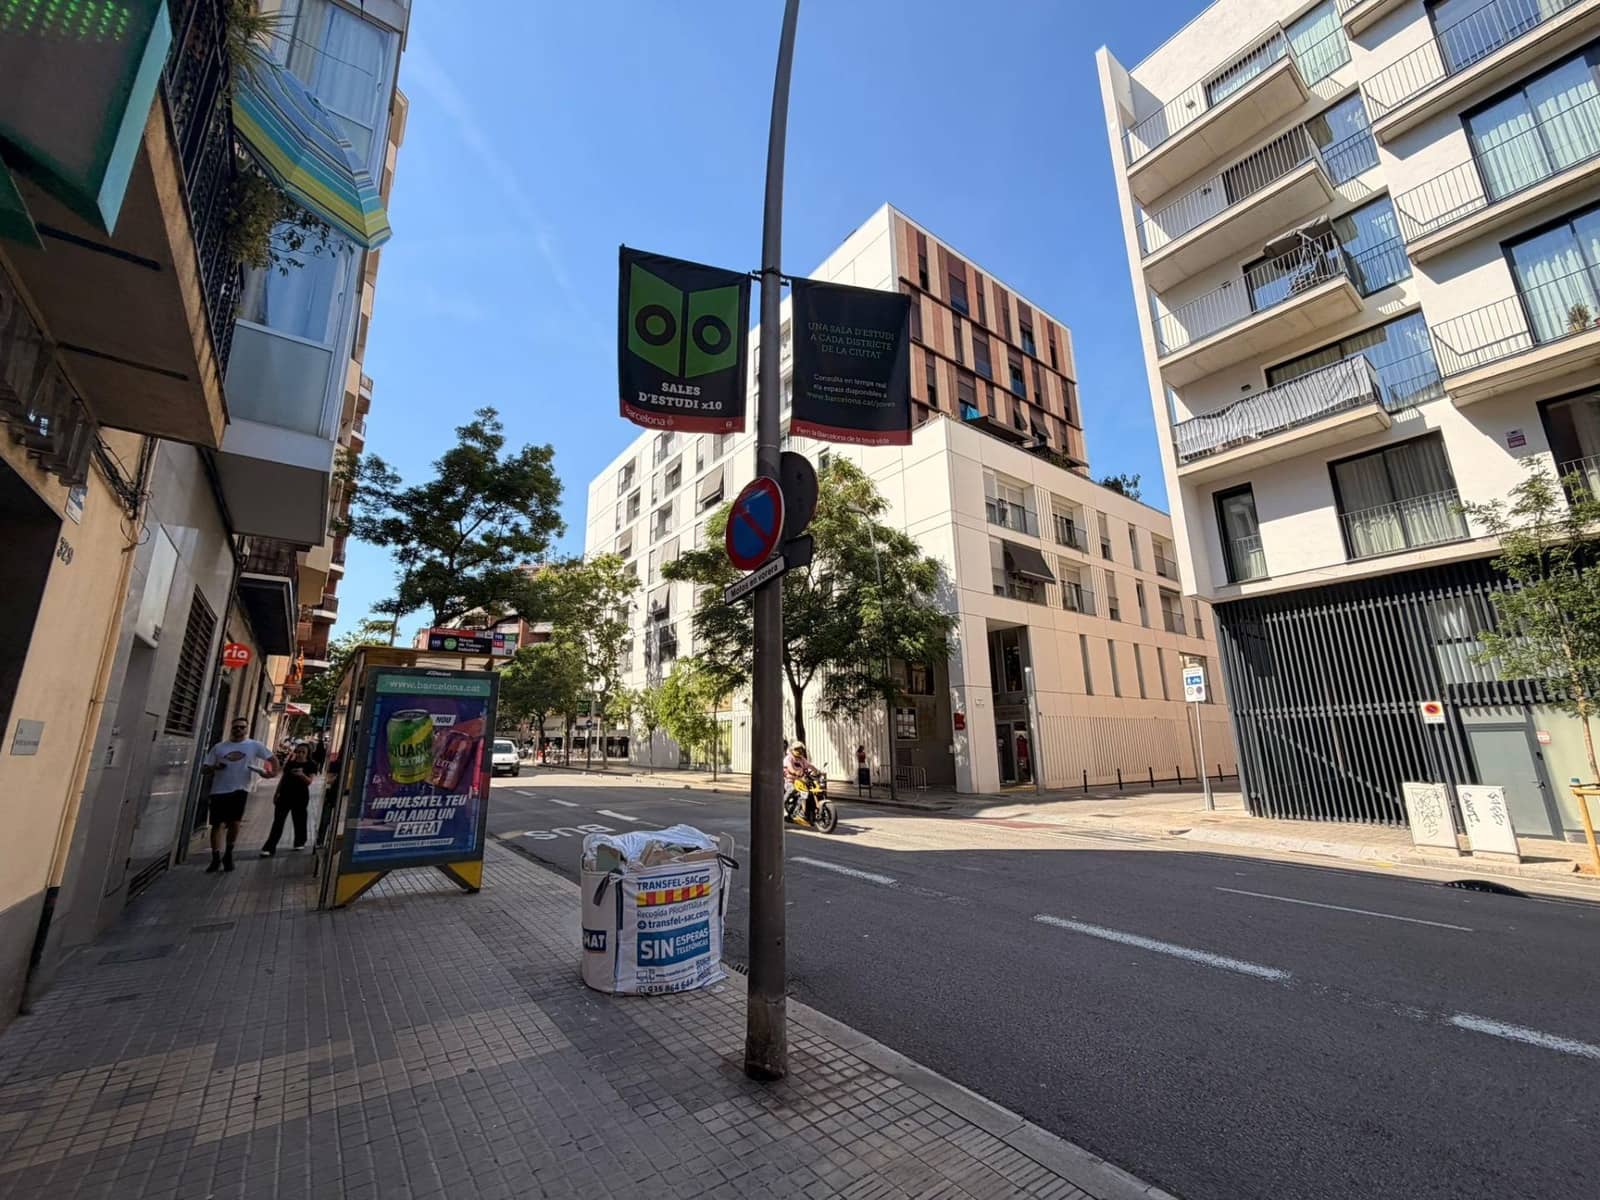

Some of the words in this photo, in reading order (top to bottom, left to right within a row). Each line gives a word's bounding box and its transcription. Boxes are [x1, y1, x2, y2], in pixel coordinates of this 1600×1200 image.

[808, 322, 829, 332] UNA
[830, 325, 853, 335] SALA
[855, 328, 896, 341] D'ESTUDI
[819, 334, 845, 345] CADA
[846, 338, 893, 351] DISTRICTE
[822, 344, 834, 353] DE
[836, 346, 848, 354] LA
[849, 348, 881, 359] CIUTAT
[661, 382, 702, 396] SALES
[638, 391, 699, 409] D'ESTUDI
[701, 400, 723, 410] x10
[731, 582, 749, 597] Motos
[224, 645, 249, 659] ria
[390, 680, 481, 693] www.barcelona.cat
[436, 716, 452, 724] NOU
[371, 796, 428, 810] IMPULSA
[428, 795, 443, 807] EL
[446, 794, 467, 806] TEU
[384, 810, 406, 823] DIA
[406, 808, 437, 821] AMB
[438, 807, 456, 820] UN
[400, 821, 439, 835] EXTRA
[637, 908, 667, 920] Recogida
[648, 910, 710, 929] transfel-sac.com
[640, 937, 675, 960] SIN
[676, 928, 709, 946] ESPERAS
